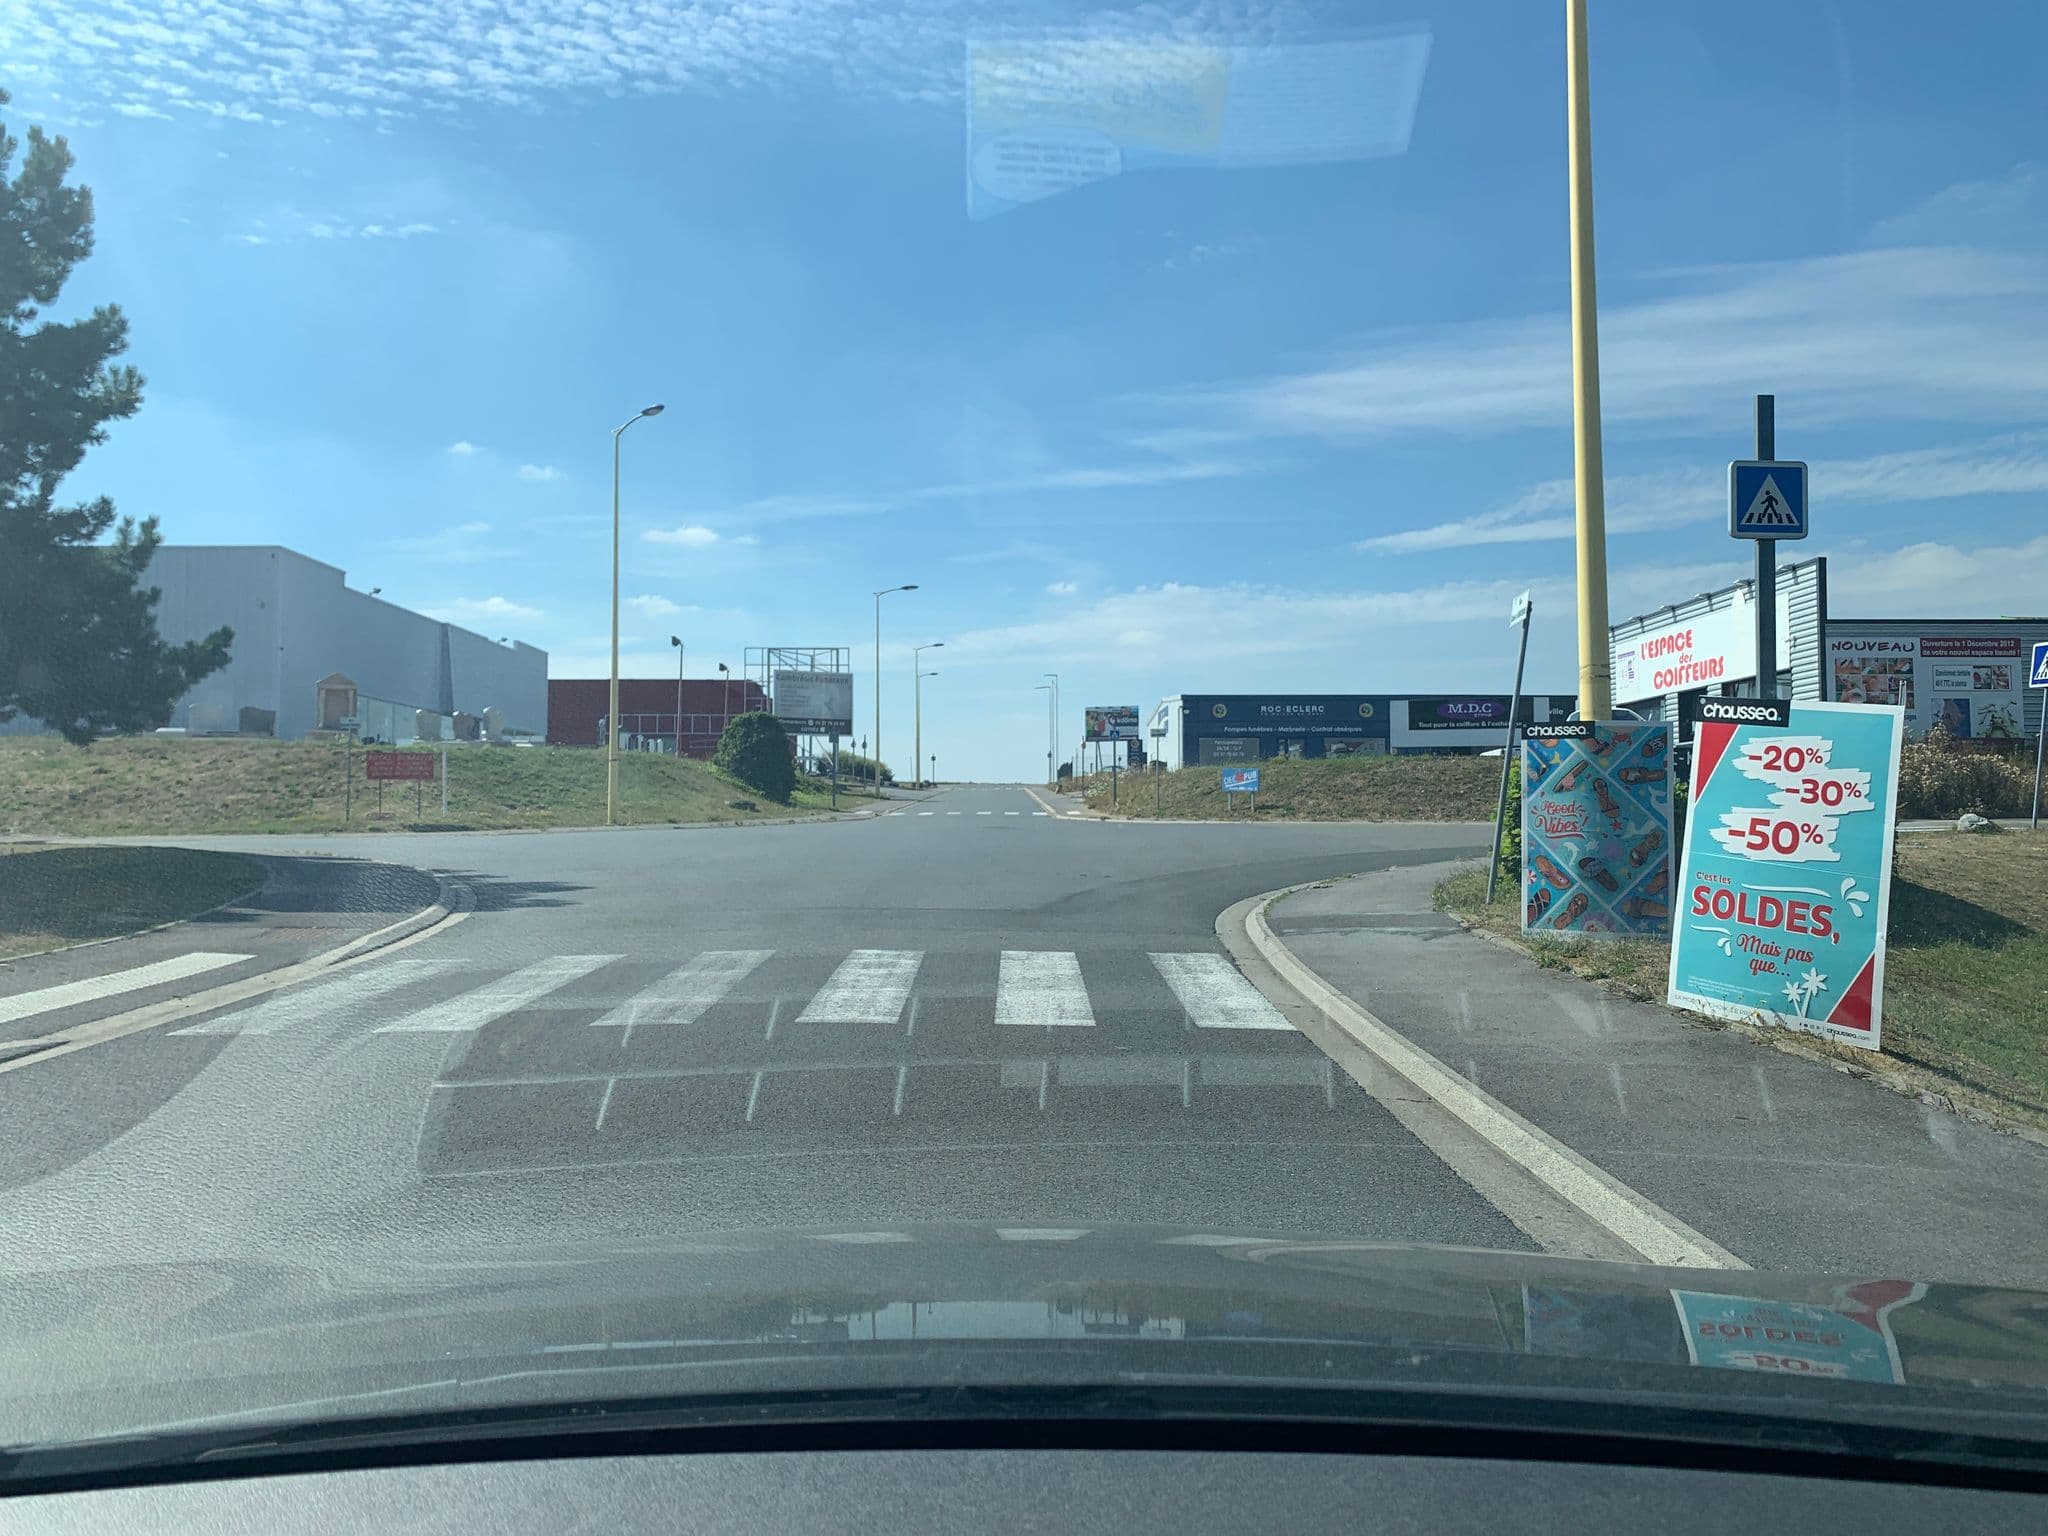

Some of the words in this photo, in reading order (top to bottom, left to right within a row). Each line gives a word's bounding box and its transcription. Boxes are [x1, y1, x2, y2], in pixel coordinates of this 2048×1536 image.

[1640, 629, 1693, 660] L'ESPACE
[1831, 640, 1915, 653] NOUVEAU
[1922, 639, 1954, 648] Ouverture
[1967, 639, 1999, 648] Décembre
[1679, 652, 1693, 664] des
[1922, 649, 1931, 657] de
[1949, 649, 1971, 657] nouvel
[1971, 650, 1994, 658] espace
[1653, 655, 1724, 690] COIFFEURS
[1448, 703, 1492, 713] M.D.C
[1703, 703, 1778, 721] chaussea
[1527, 725, 1587, 737] chaussea
[1748, 745, 1823, 773] -20%
[1785, 778, 1862, 807] -30%
[1541, 801, 1577, 815] Good
[1728, 817, 1824, 855] -50%
[1696, 872, 1717, 882] C'est
[1719, 875, 1732, 885] les
[1691, 885, 1840, 945] SOLDES,
[1736, 933, 1782, 957] Mais
[1784, 947, 1815, 964] pas
